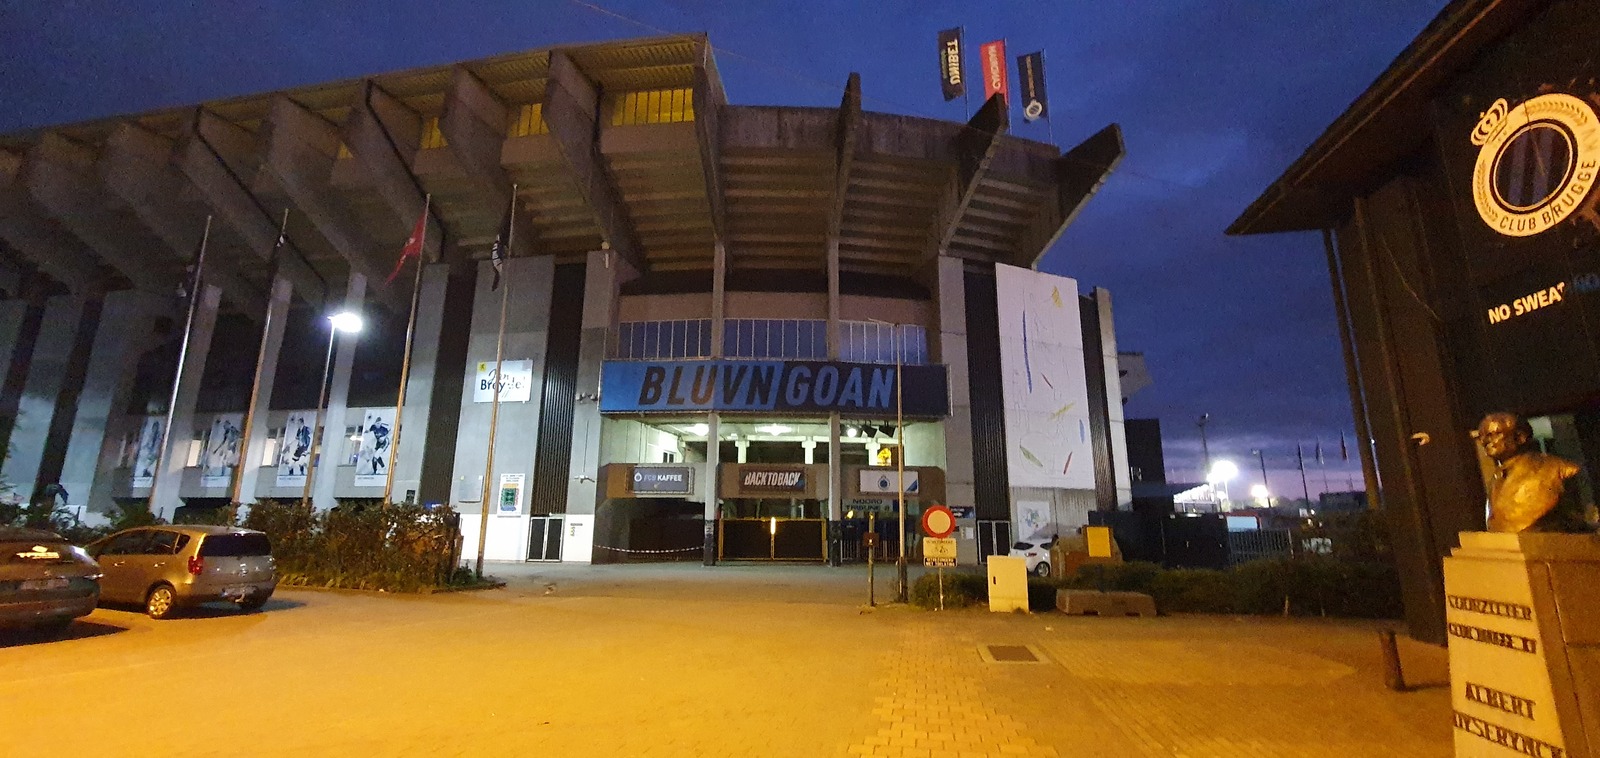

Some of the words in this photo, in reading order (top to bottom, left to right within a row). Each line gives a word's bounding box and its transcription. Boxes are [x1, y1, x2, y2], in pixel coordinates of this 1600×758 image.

[1499, 215, 1537, 232] CLUB
[1541, 159, 1597, 226] BRUGGE
[1488, 303, 1511, 325] NO
[1513, 281, 1565, 316] SWEAT
[638, 365, 773, 406] BLUVN
[785, 364, 897, 409] GOAN
[657, 474, 683, 482] KAFFEE
[1465, 681, 1536, 721] ALBERT
